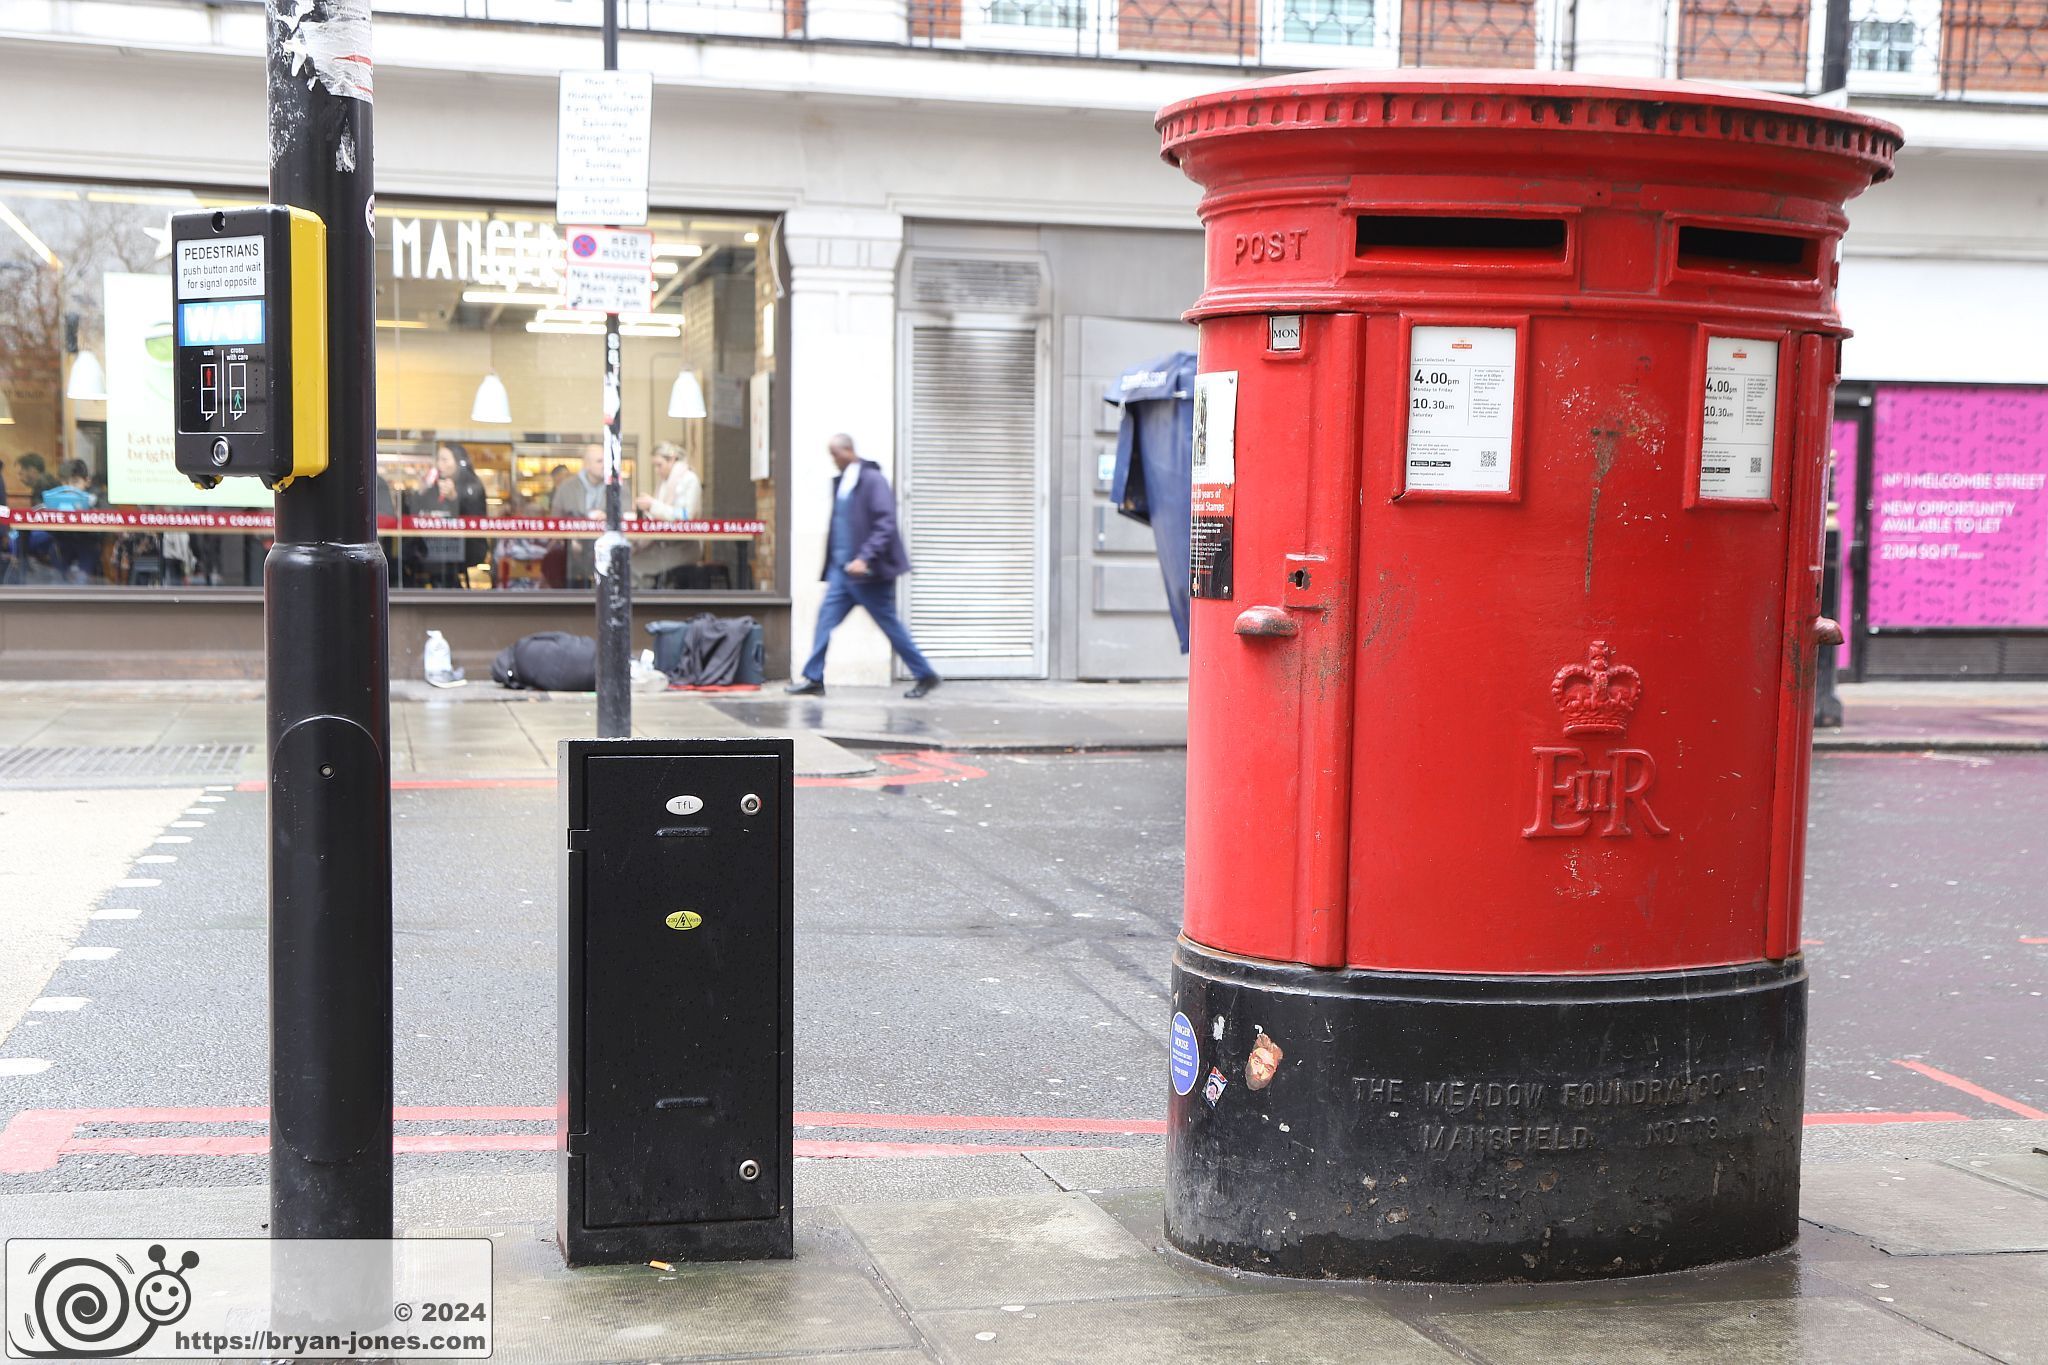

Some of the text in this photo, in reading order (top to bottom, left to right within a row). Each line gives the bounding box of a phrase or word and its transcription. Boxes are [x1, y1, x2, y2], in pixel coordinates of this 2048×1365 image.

[184, 243, 260, 260] PEDESTRIANS
[602, 248, 646, 261] ROUTE
[1235, 230, 1309, 266] POST
[183, 262, 261, 278] push button and wait
[187, 277, 257, 291] for signal opposite
[1272, 329, 1299, 339] MON
[203, 348, 214, 356] wait
[1414, 369, 1460, 386] 4.00pm
[1412, 398, 1455, 410] 10.30am
[1911, 472, 1993, 490] MELCOMBE
[1994, 473, 2046, 490] STREET
[1205, 502, 1225, 513] Stamps
[1881, 501, 2016, 517] NEW OPPORTUNITY
[26, 511, 275, 528] LATTE MOCHA CROISSANTS COOKIE
[412, 517, 466, 530] TOASTIES
[479, 518, 545, 531] BAGUETTES
[641, 520, 711, 533] CAPPUCCINO
[723, 521, 765, 533] SALADS
[1880, 517, 2002, 534] AVAILABLE TO LET
[675, 801, 694, 810] TfL
[1352, 1076, 1404, 1105] THE
[1424, 1080, 1545, 1107] MEADOW
[1561, 1076, 1680, 1106] FOUNDRY
[1420, 1124, 1592, 1151] MANSFIELD
